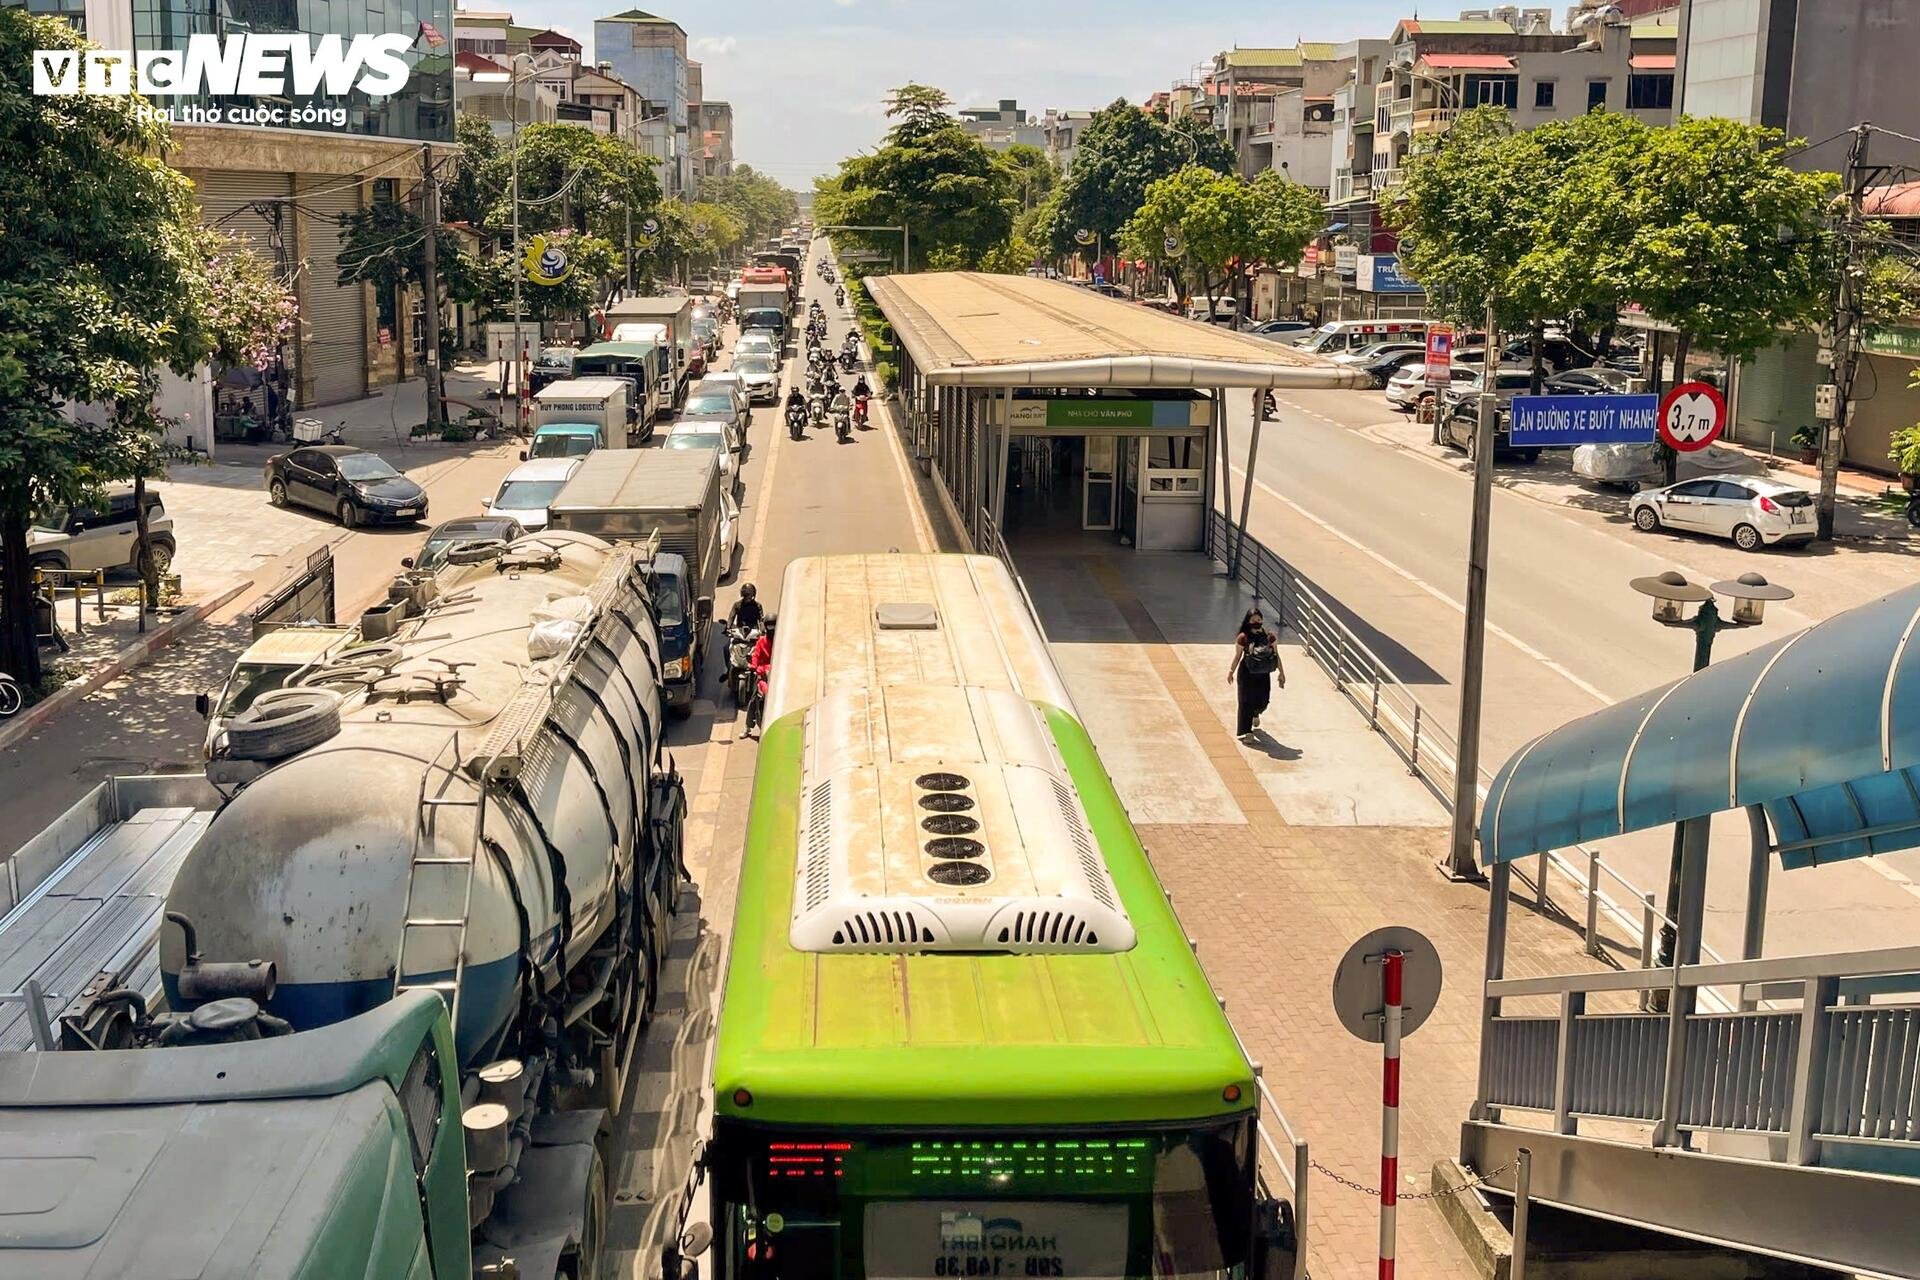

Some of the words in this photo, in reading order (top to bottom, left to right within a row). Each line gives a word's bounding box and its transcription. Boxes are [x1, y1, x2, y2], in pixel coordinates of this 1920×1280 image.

[554, 403, 573, 411] PHONG
[575, 403, 605, 411] LOGISTICS
[1513, 407, 1534, 431] LÀN
[1536, 405, 1570, 431] ĐƯỜNG
[1572, 411, 1586, 430] XE
[1589, 405, 1615, 430] BUÝT
[1619, 409, 1654, 430] NHANH
[1671, 404, 1694, 431] 3,7
[1698, 419, 1710, 430] m
